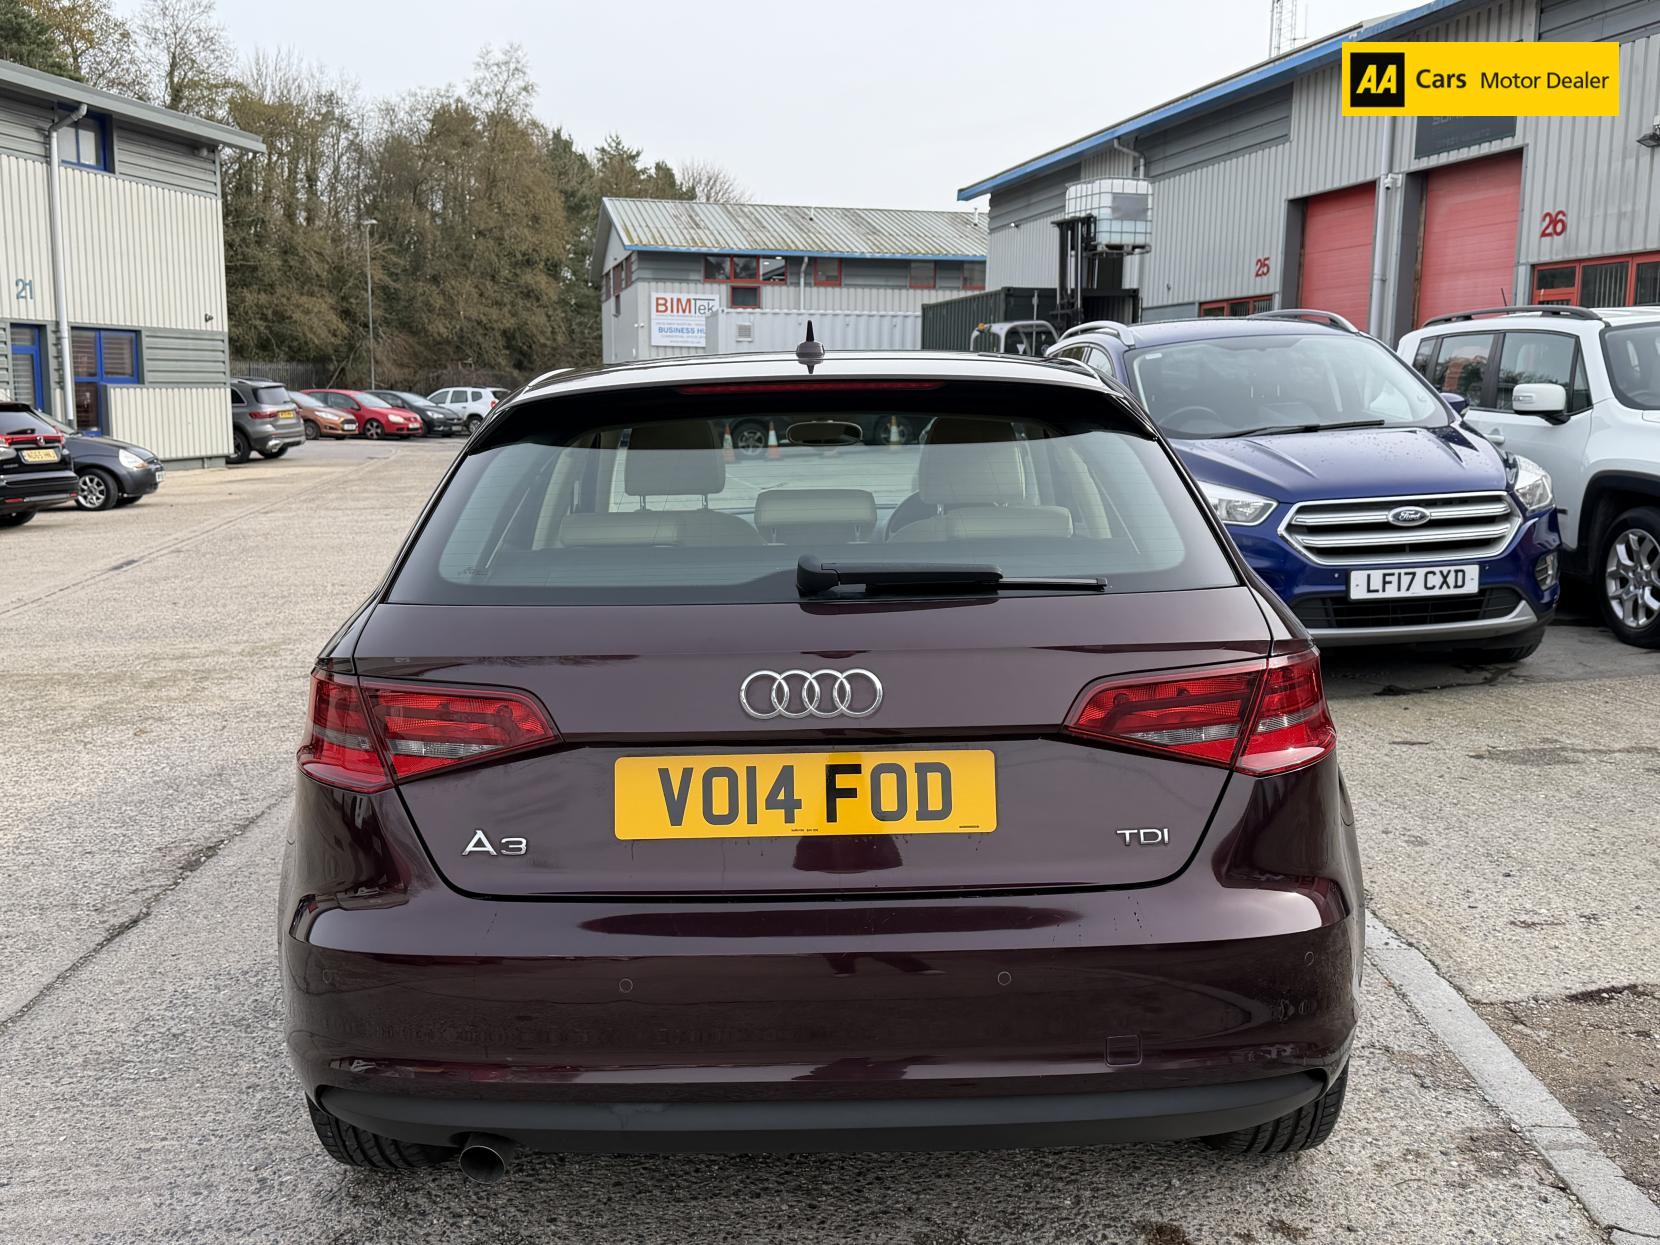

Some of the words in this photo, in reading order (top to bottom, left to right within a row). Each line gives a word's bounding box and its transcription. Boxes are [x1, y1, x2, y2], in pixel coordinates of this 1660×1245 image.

[1539, 209, 1567, 239] 26
[1254, 256, 1271, 278] 25
[15, 278, 34, 300] 21
[655, 296, 716, 315] BIMTek
[658, 326, 696, 335] BUSINESS
[1398, 510, 1422, 521] Ford
[1365, 571, 1416, 594] LF17
[1423, 569, 1466, 591] CXD
[657, 764, 802, 827] VO14
[824, 761, 953, 823] FOD
[461, 829, 527, 856] A3
[1116, 827, 1169, 846] TDI
